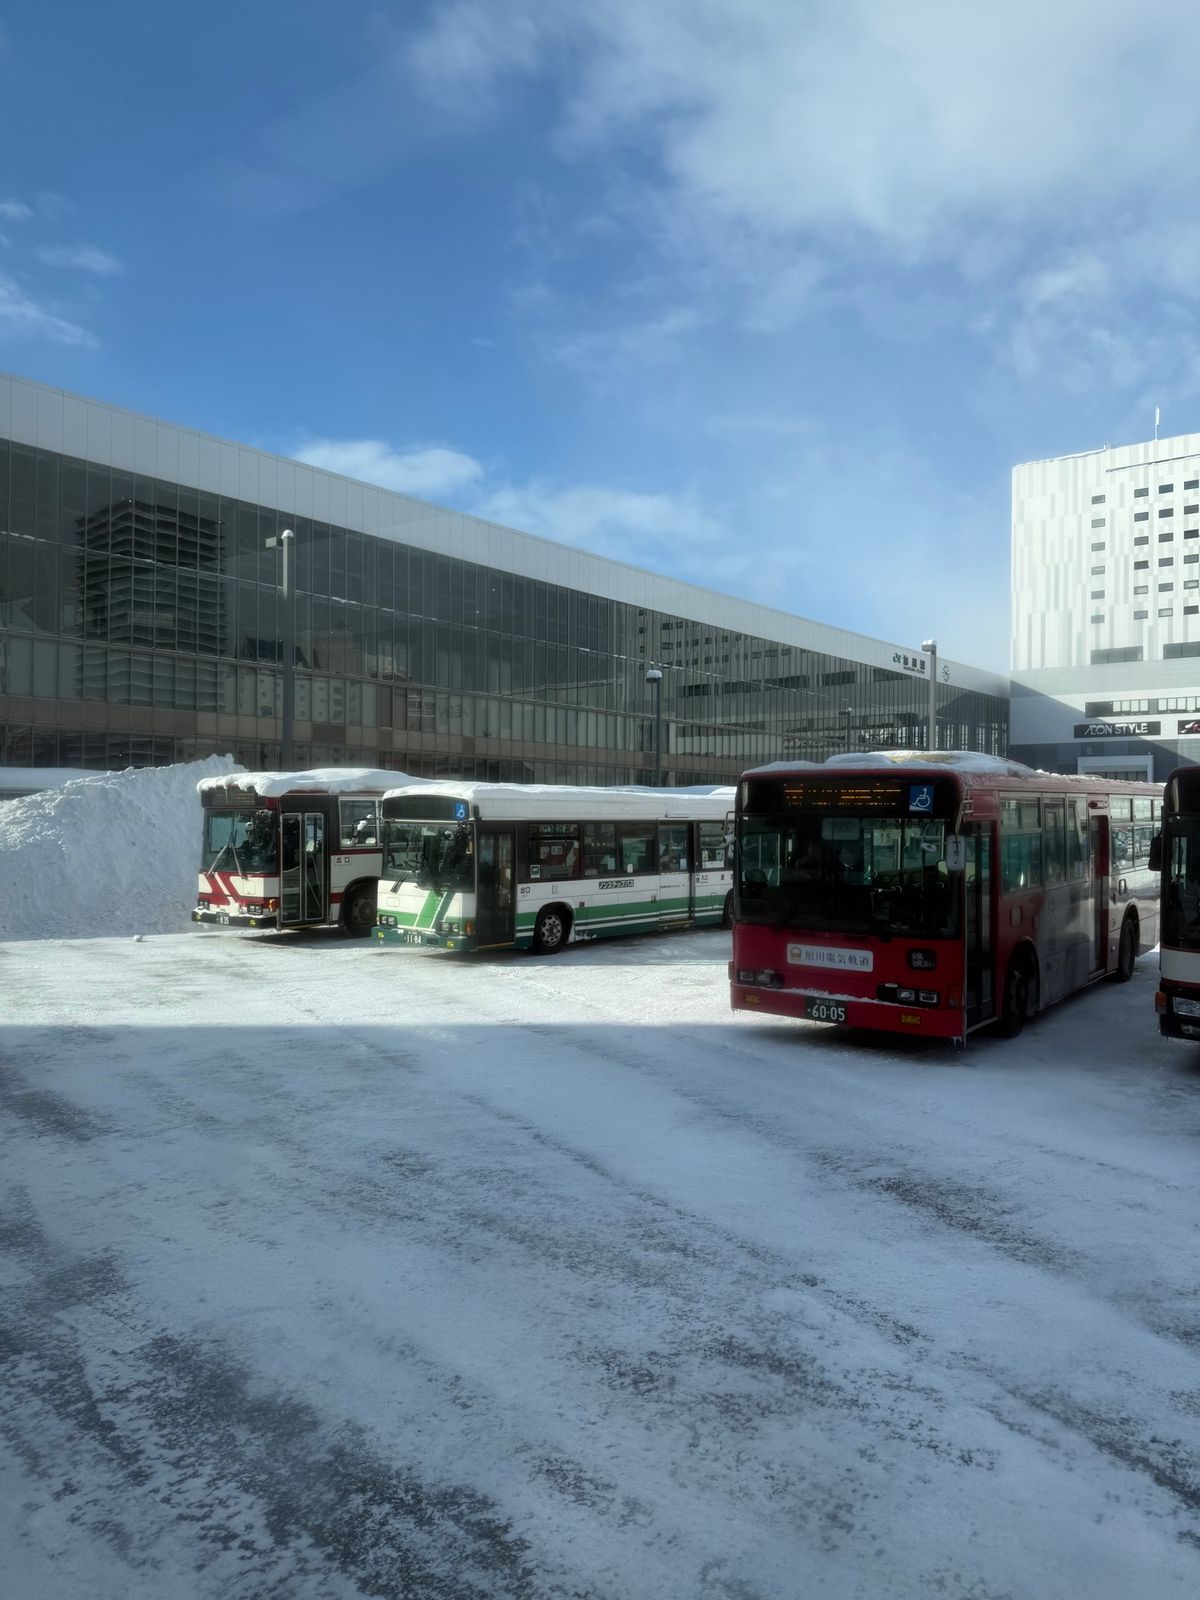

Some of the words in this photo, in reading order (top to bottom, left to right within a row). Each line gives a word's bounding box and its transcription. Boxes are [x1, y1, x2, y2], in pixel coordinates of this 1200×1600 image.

[1114, 722, 1149, 734] STYLE
[805, 951, 870, 966] 旭川電気軌道
[812, 1004, 845, 1021] 60-05
